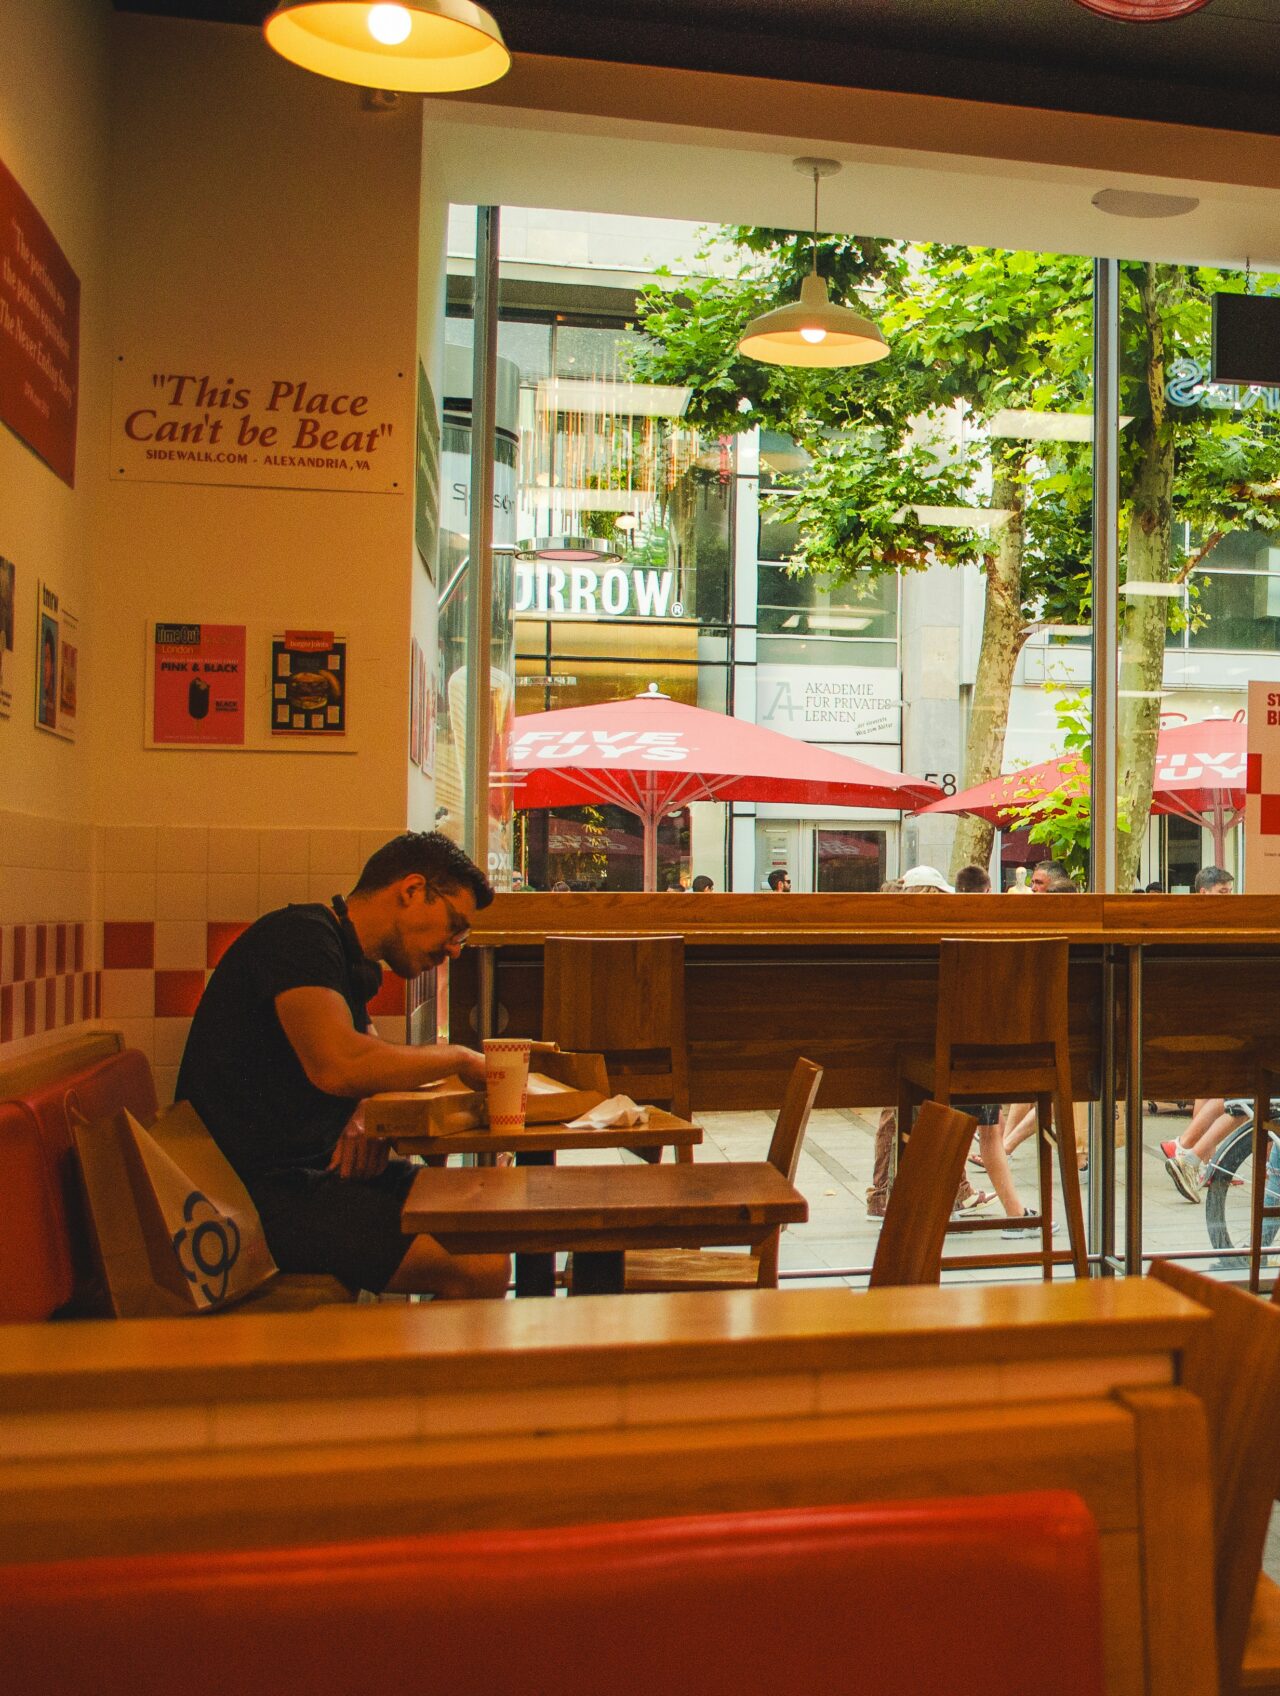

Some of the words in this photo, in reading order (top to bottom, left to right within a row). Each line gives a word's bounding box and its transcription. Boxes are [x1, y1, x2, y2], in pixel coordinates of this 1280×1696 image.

[16, 316, 38, 364] Never
[37, 342, 59, 391] Ending
[153, 374, 251, 410] "This
[266, 380, 369, 416] Place
[124, 409, 223, 444] Can't
[237, 414, 278, 448] be
[292, 418, 393, 452] Beat"
[146, 449, 248, 464] SIDEWALK.COM
[157, 625, 182, 643] Time
[162, 646, 194, 654] London
[161, 663, 187, 671] PINK
[192, 664, 199, 672] &
[204, 664, 238, 673] BLACK
[805, 682, 874, 696] AKADEMIE
[834, 698, 892, 710] PRIVATES
[805, 711, 856, 723] LERNEN
[515, 731, 684, 745] FIVE
